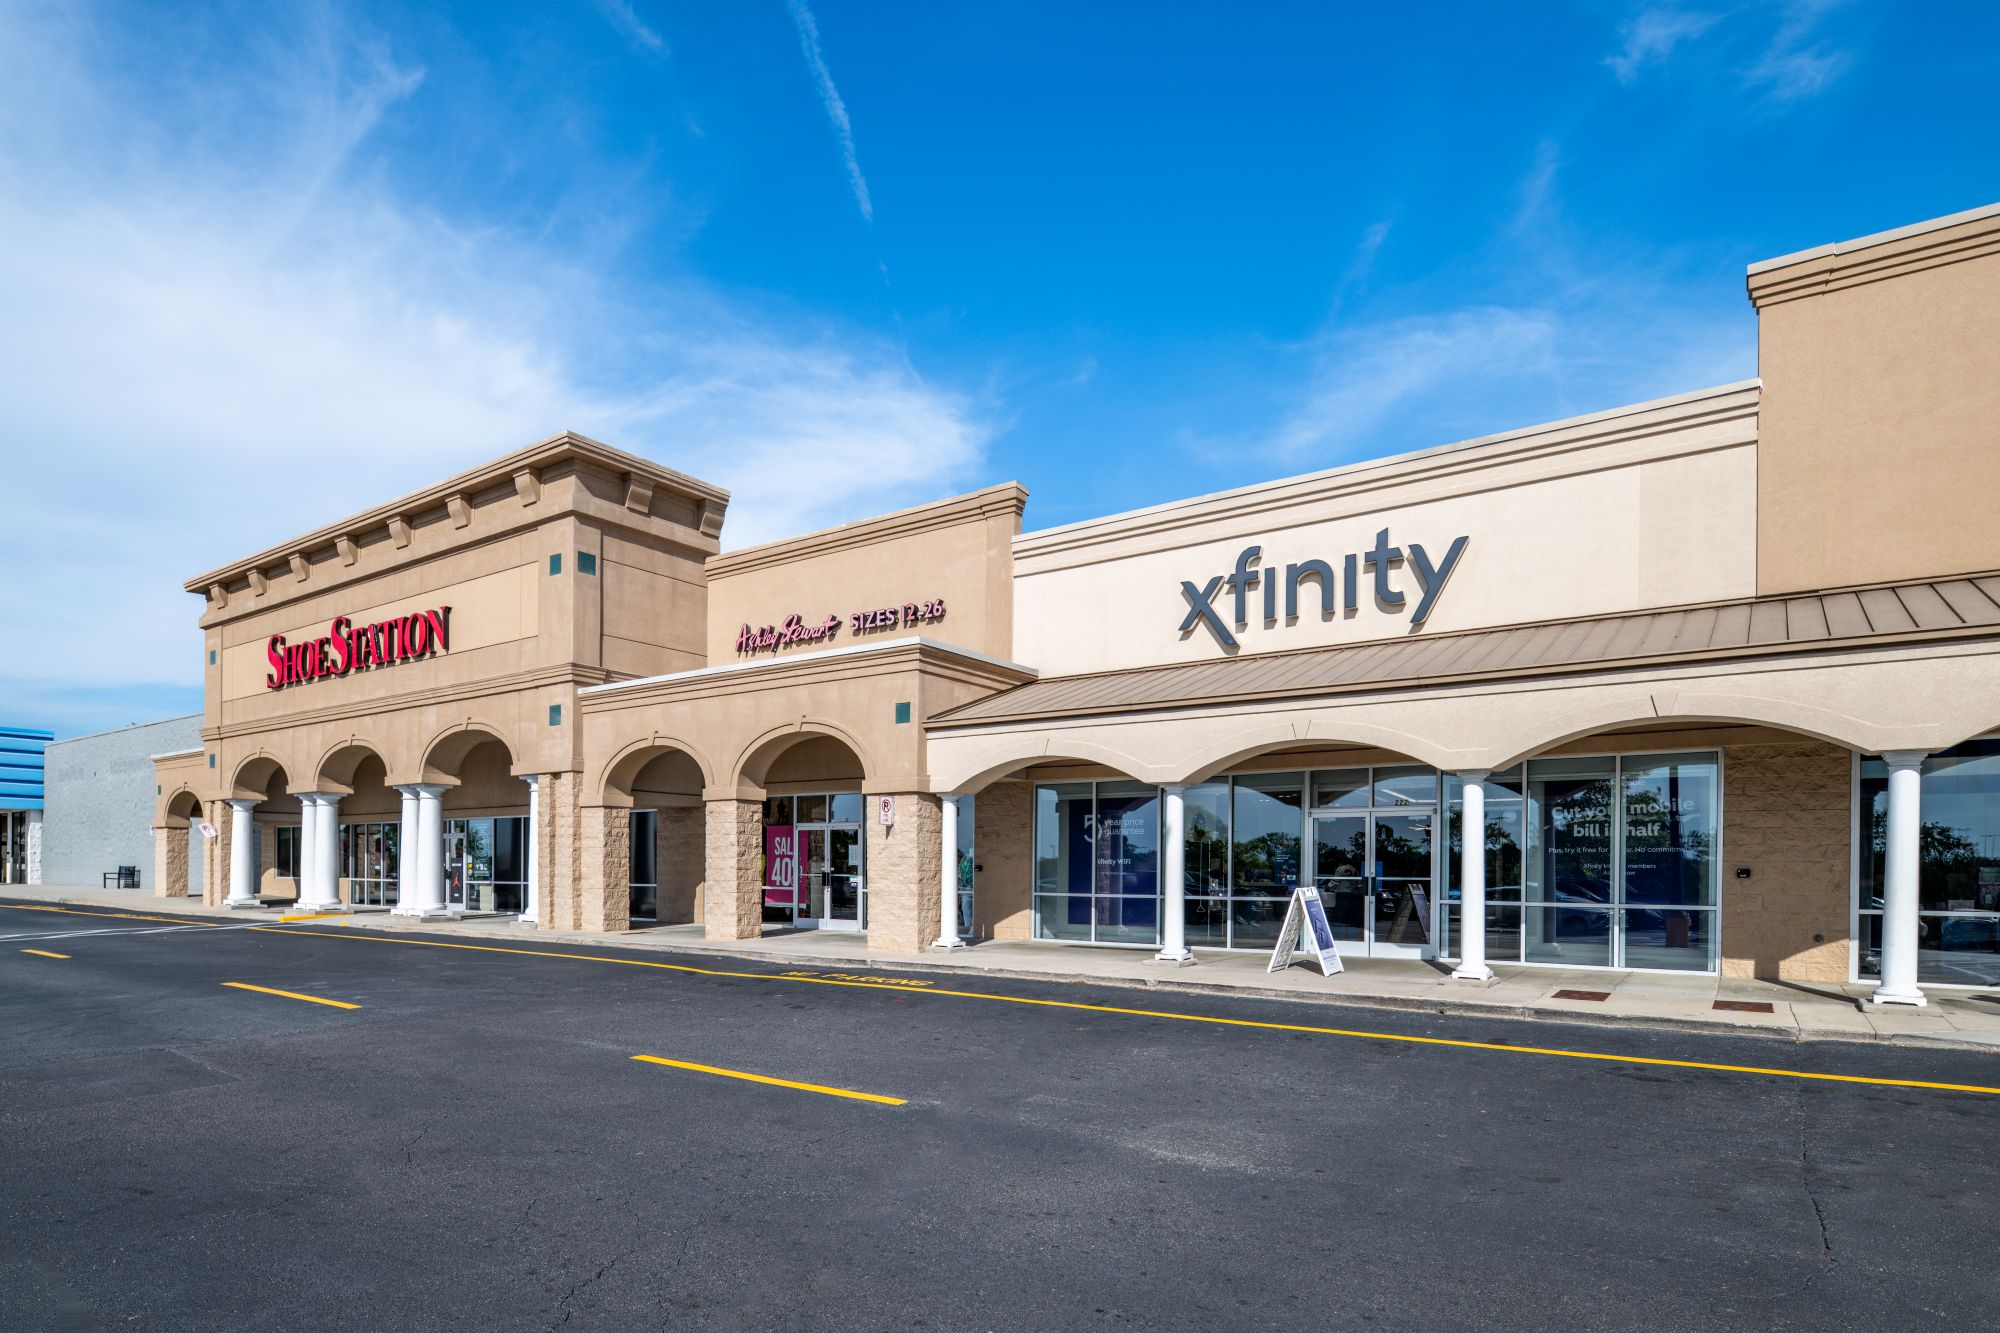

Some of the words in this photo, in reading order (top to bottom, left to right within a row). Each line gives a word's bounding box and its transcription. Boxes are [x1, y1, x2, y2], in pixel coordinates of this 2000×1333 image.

[1178, 527, 1470, 647] xfinity
[736, 622, 779, 653] Ashley
[781, 613, 840, 645] Stewart
[849, 607, 897, 631] SIZES
[900, 599, 945, 624] 12-26
[1631, 798, 1695, 816] mobile
[1104, 819, 1121, 828] year
[1124, 818, 1145, 826] price
[1573, 823, 1600, 837] bill
[1626, 823, 1662, 837] half
[1104, 828, 1145, 838] guarantee
